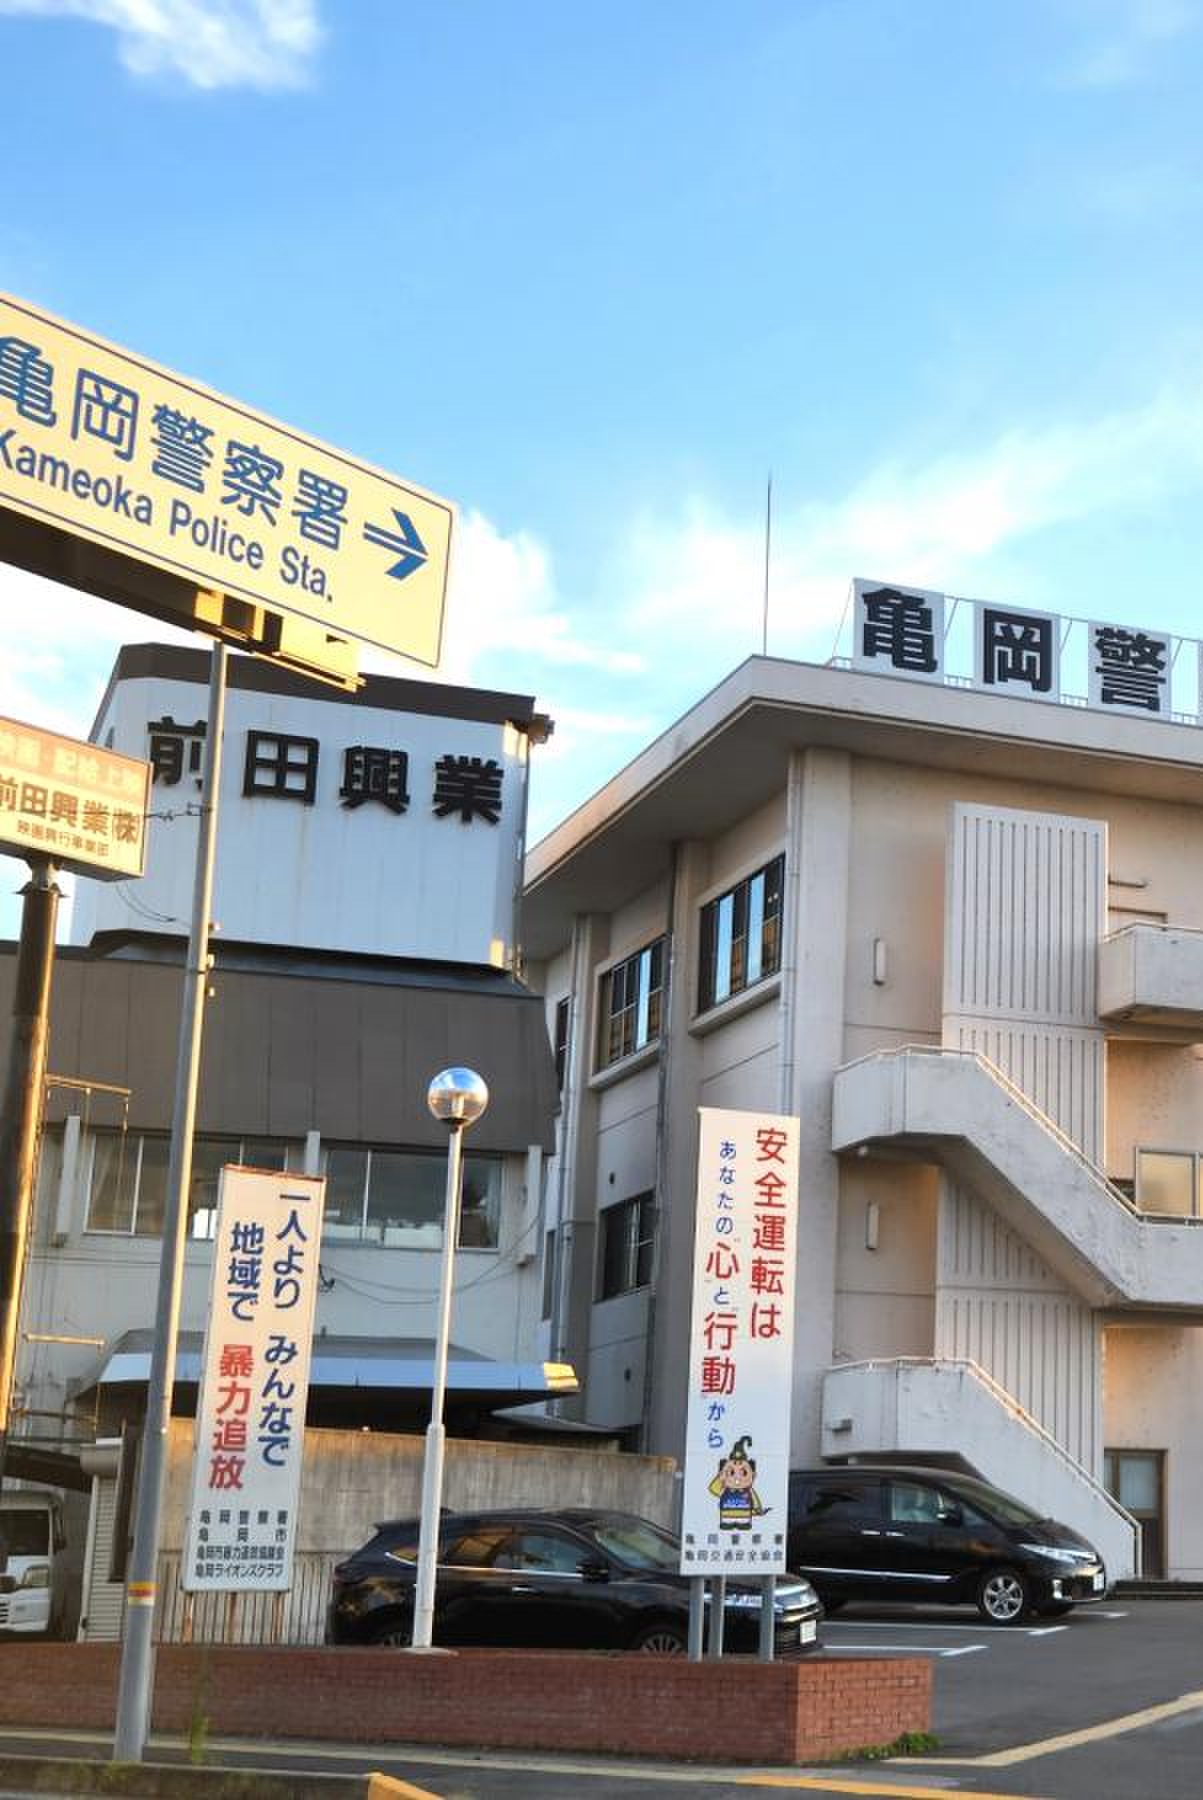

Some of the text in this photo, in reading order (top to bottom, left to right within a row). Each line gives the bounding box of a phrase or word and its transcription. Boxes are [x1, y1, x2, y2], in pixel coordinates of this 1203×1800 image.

[0, 335, 349, 551] 亀岡警察署
[0, 428, 333, 602] Kameoka Police Sta.
[147, 716, 505, 825] 前田興業
[258, 1194, 311, 1467] 一人より みんなで
[750, 1127, 788, 1338] 安全運転は
[209, 1221, 265, 1490] 地域で 暴力追放
